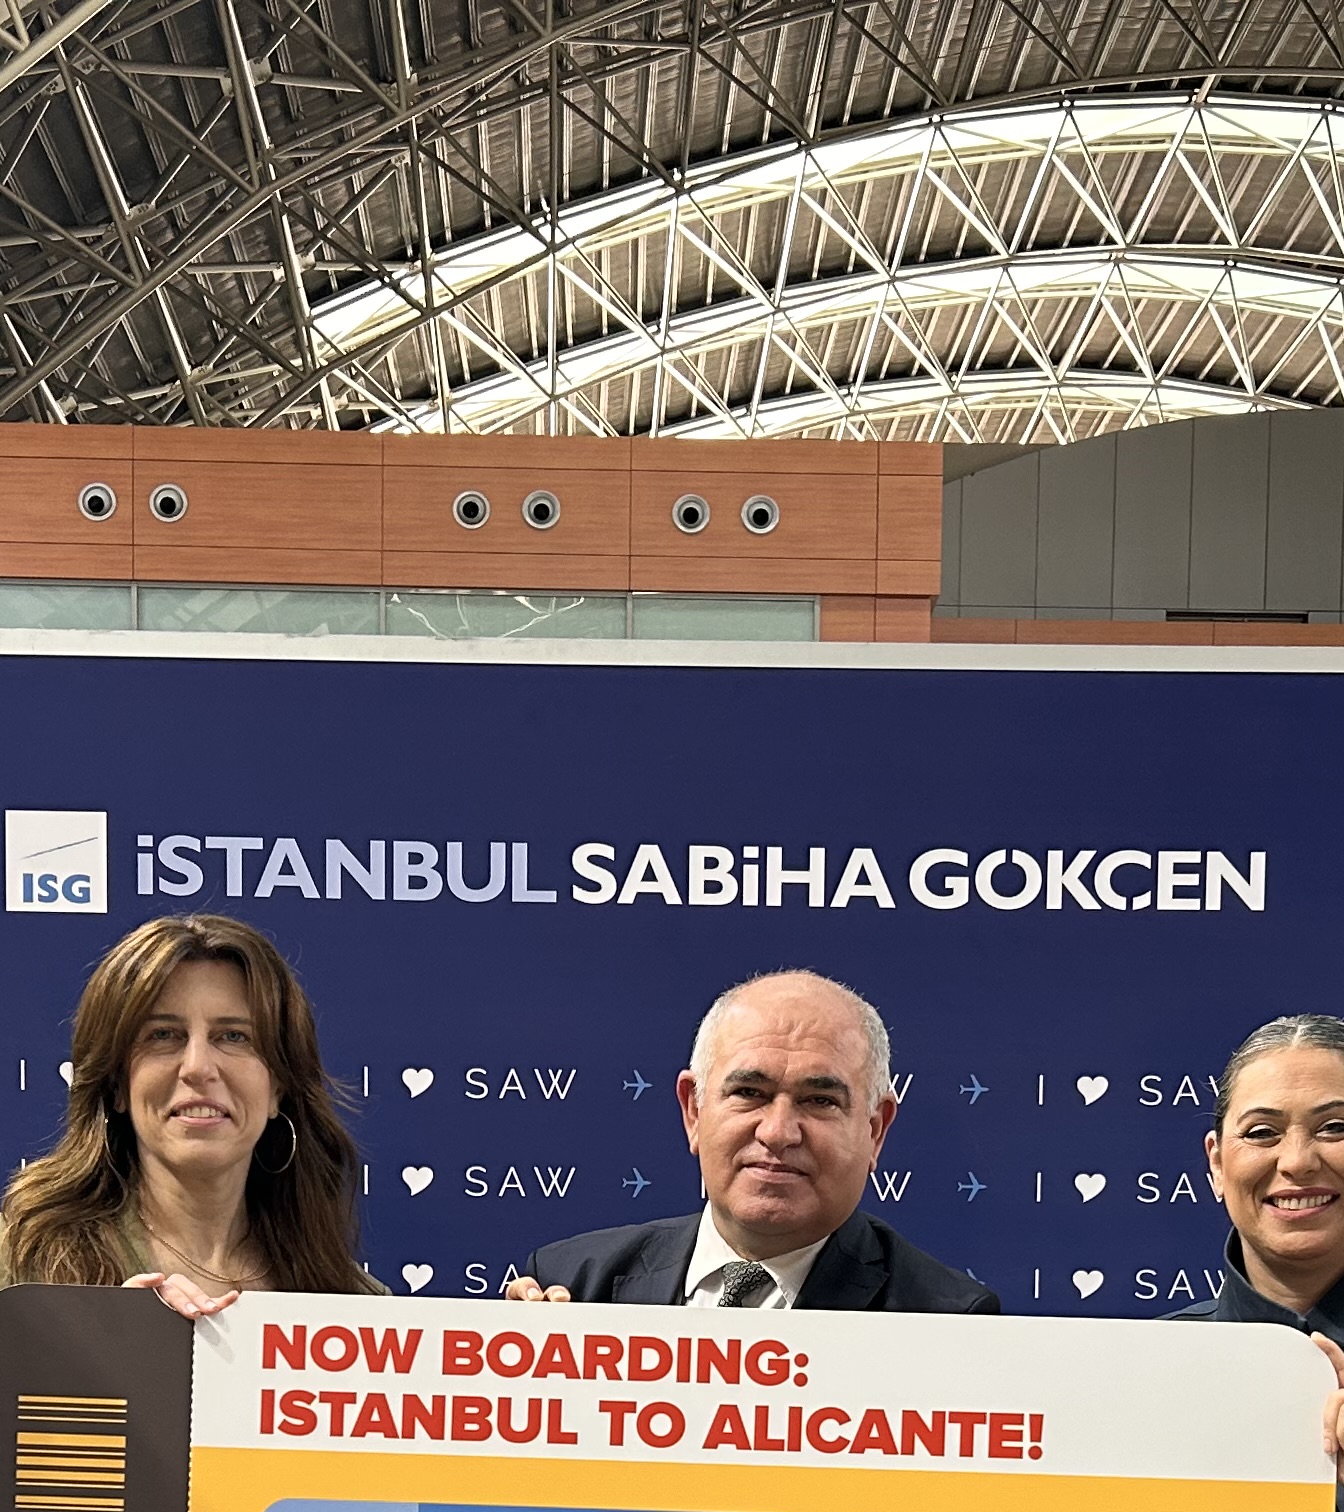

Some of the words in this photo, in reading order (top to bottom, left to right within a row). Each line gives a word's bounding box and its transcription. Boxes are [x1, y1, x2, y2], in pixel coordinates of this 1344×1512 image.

[24, 875, 89, 903] ISG
[466, 1068, 576, 1099] SAW
[465, 1166, 575, 1197] SAW
[464, 1263, 520, 1295] SA
[261, 1323, 422, 1375] NOW
[441, 1331, 809, 1388] BOARDING:
[261, 1390, 577, 1444] ISTANBUL
[600, 1401, 685, 1447] TO
[703, 1404, 1044, 1460] ALICANTE!
